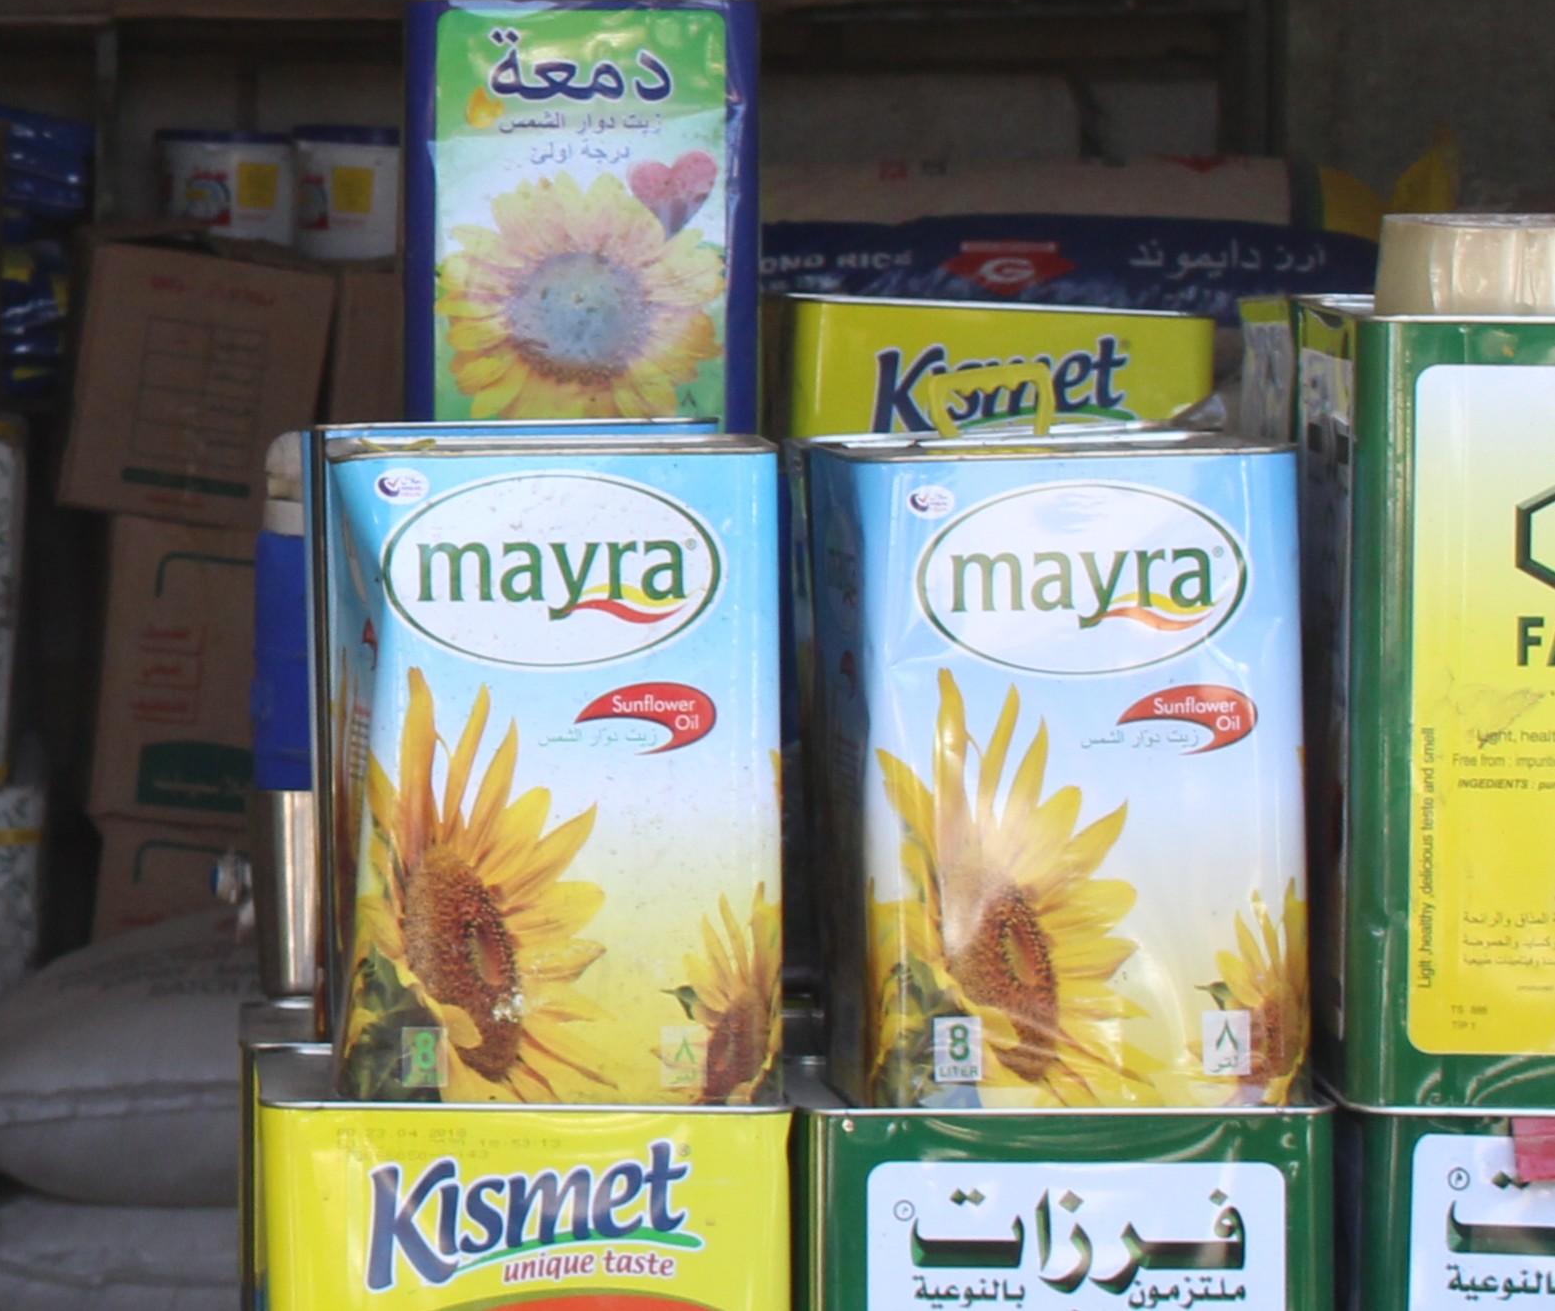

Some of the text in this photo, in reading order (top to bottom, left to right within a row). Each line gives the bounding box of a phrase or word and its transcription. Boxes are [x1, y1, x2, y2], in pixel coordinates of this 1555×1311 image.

[490, 27, 673, 102] دمعة
[498, 113, 566, 134] الشمس
[576, 113, 615, 134] دوار
[416, 537, 688, 622] mayra
[949, 545, 1215, 630] mayra
[611, 694, 697, 715] Sunflower
[1153, 696, 1238, 718] Sunflower
[675, 713, 700, 731] Oil
[1215, 714, 1241, 732] Oil
[537, 726, 583, 748] الشمس
[625, 727, 659, 747] زيت
[947, 1024, 971, 1063] 8
[366, 1140, 688, 1290] Kismet
[910, 1188, 1246, 1294] فرزات
[502, 1249, 675, 1284] unique taste
